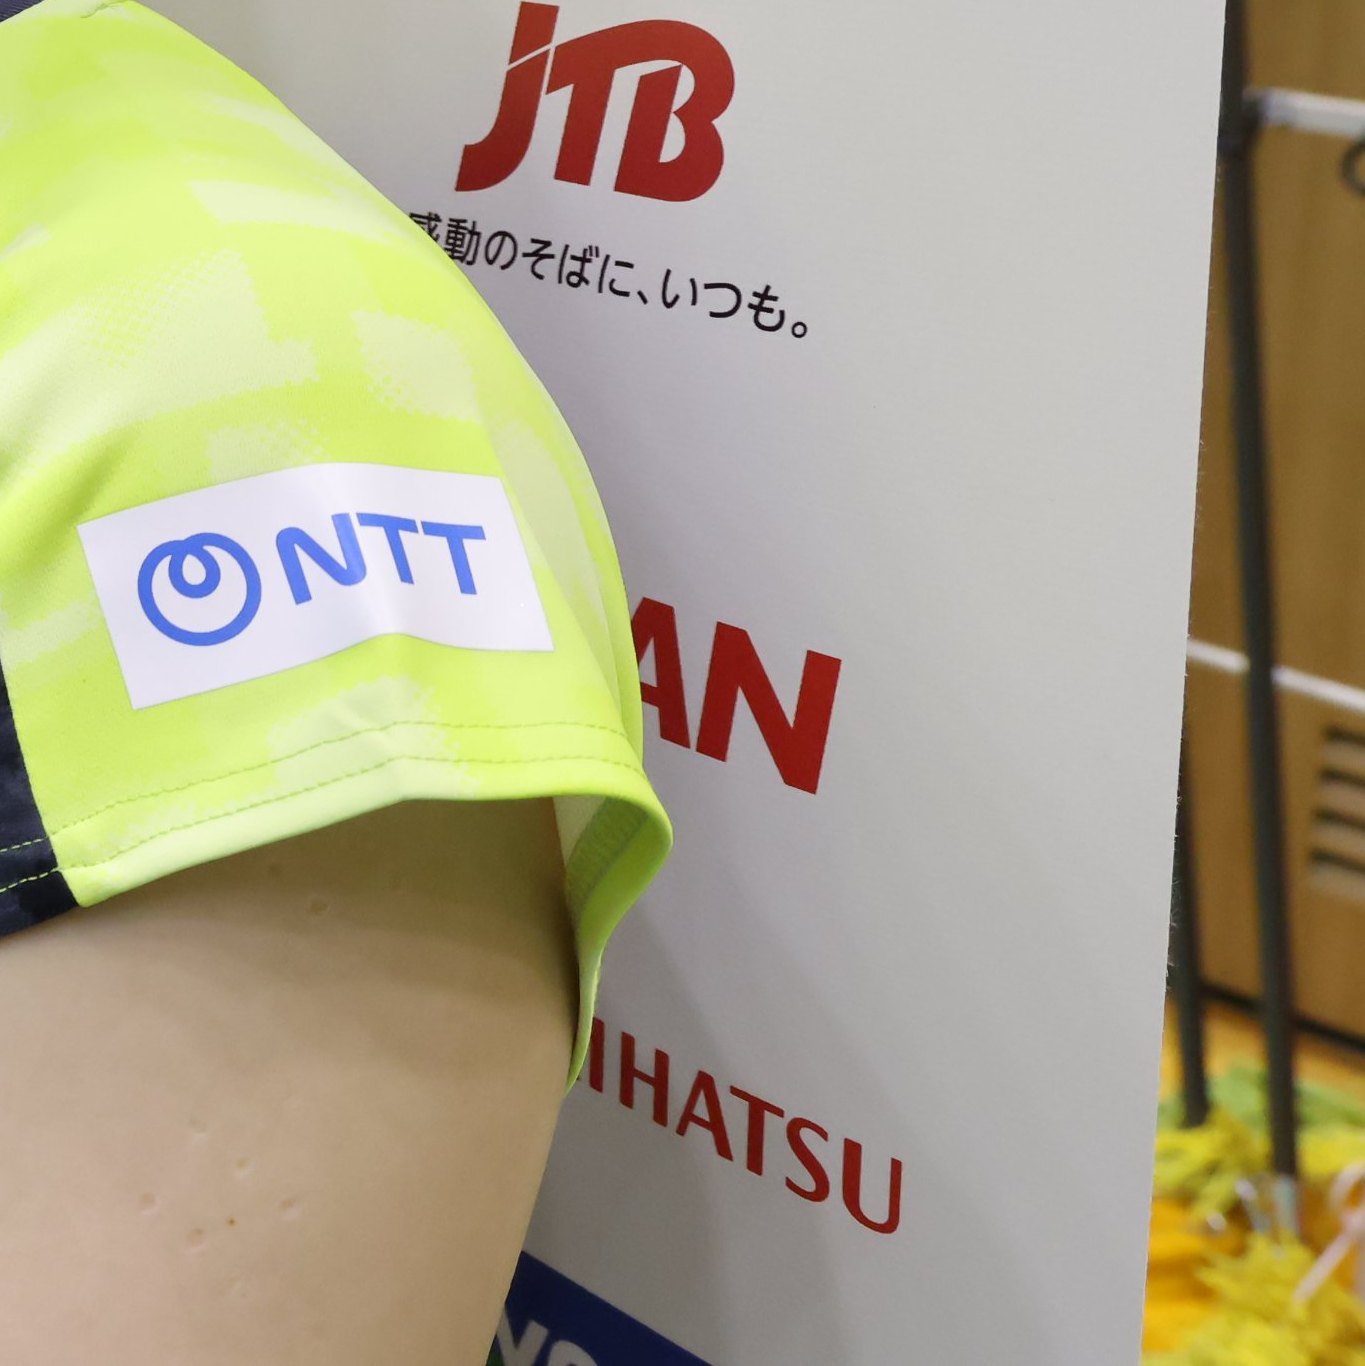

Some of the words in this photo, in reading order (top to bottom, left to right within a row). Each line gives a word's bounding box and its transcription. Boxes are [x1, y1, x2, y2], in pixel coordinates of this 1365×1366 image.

[455, 1, 735, 202] JTB
[275, 512, 486, 605] NTT
[630, 596, 842, 795] AN
[576, 1016, 902, 1235] IHATSU
